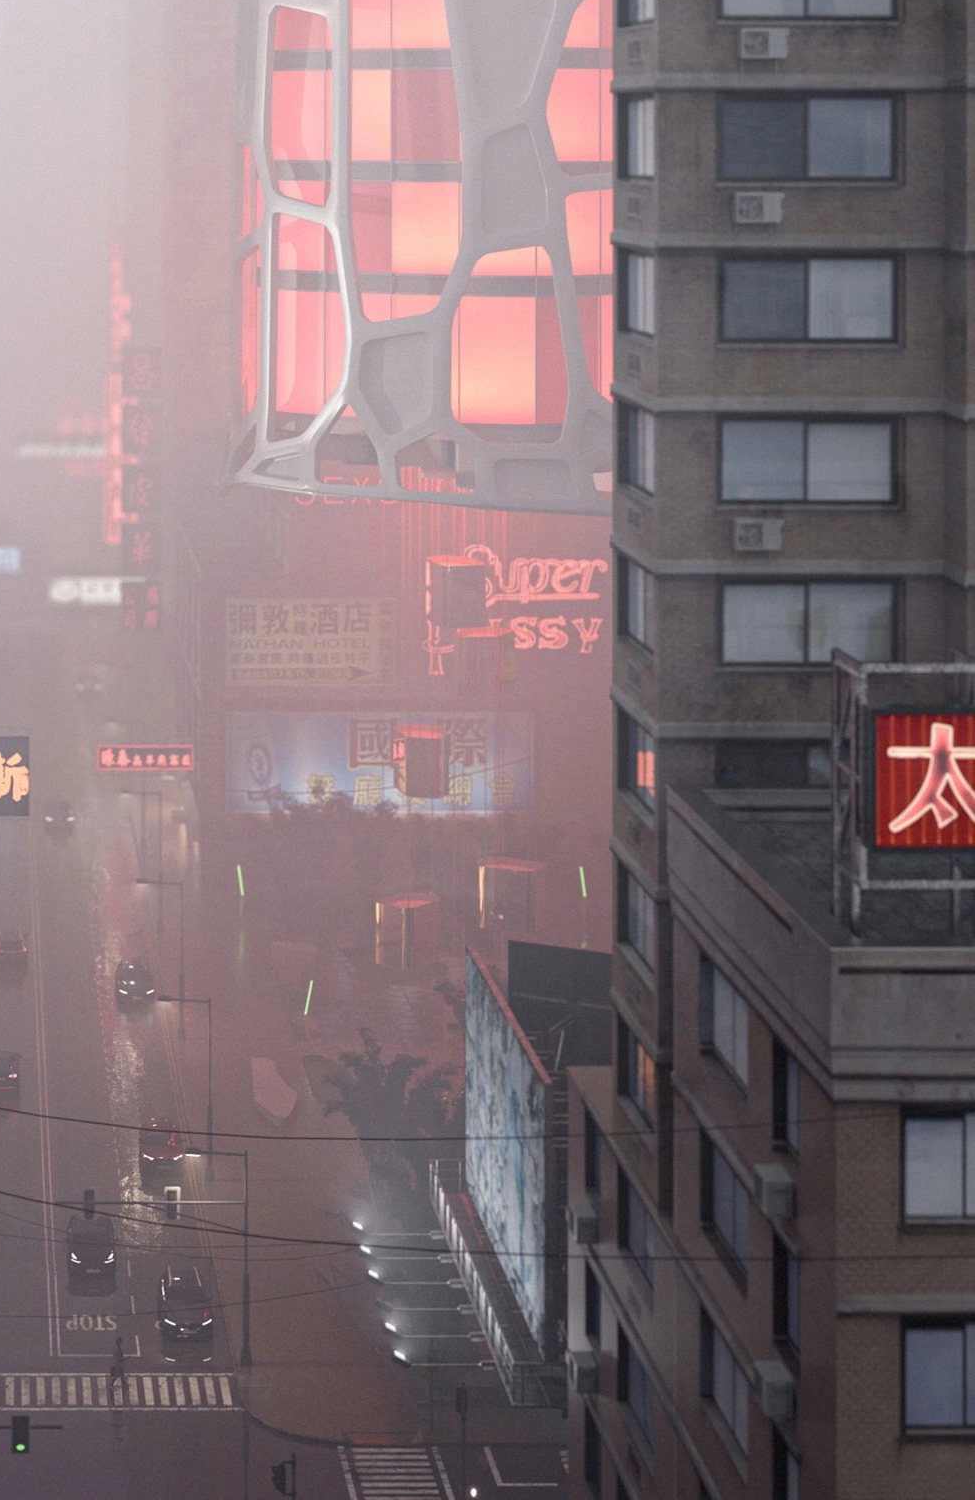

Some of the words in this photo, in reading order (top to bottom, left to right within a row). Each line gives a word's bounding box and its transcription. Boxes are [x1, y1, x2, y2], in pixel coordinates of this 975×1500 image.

[229, 638, 303, 650] NATHAN
[313, 637, 372, 650] HOTEL
[886, 722, 975, 834] 太
[65, 1315, 118, 1331] STOP
